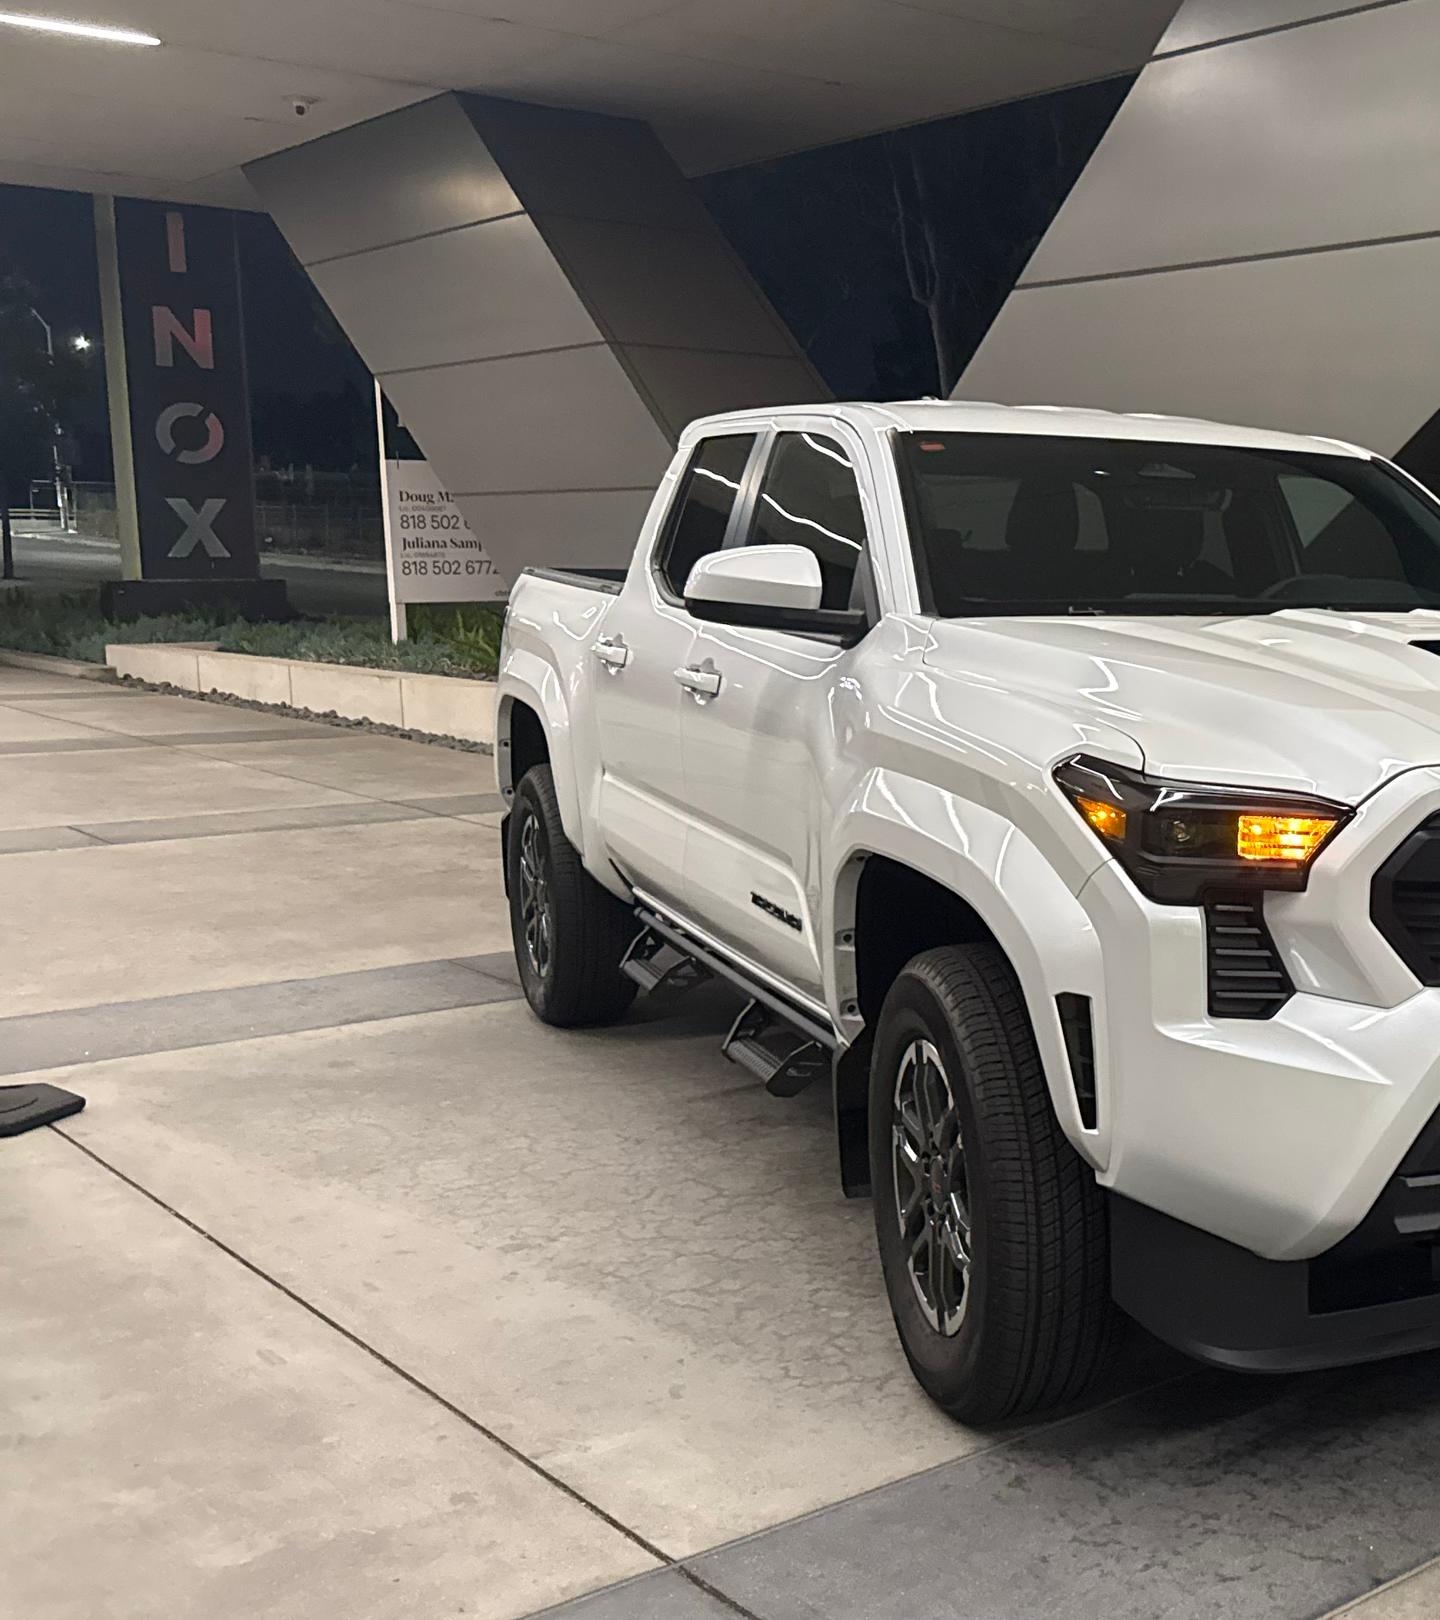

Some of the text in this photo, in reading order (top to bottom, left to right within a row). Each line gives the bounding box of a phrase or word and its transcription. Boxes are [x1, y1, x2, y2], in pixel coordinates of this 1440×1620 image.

[152, 212, 231, 558] INOX
[399, 490, 436, 504] Doug
[400, 514, 426, 530] 818
[430, 514, 460, 530] 502
[402, 537, 447, 552] Juliana
[402, 560, 428, 575] 818
[432, 560, 461, 575] 502
